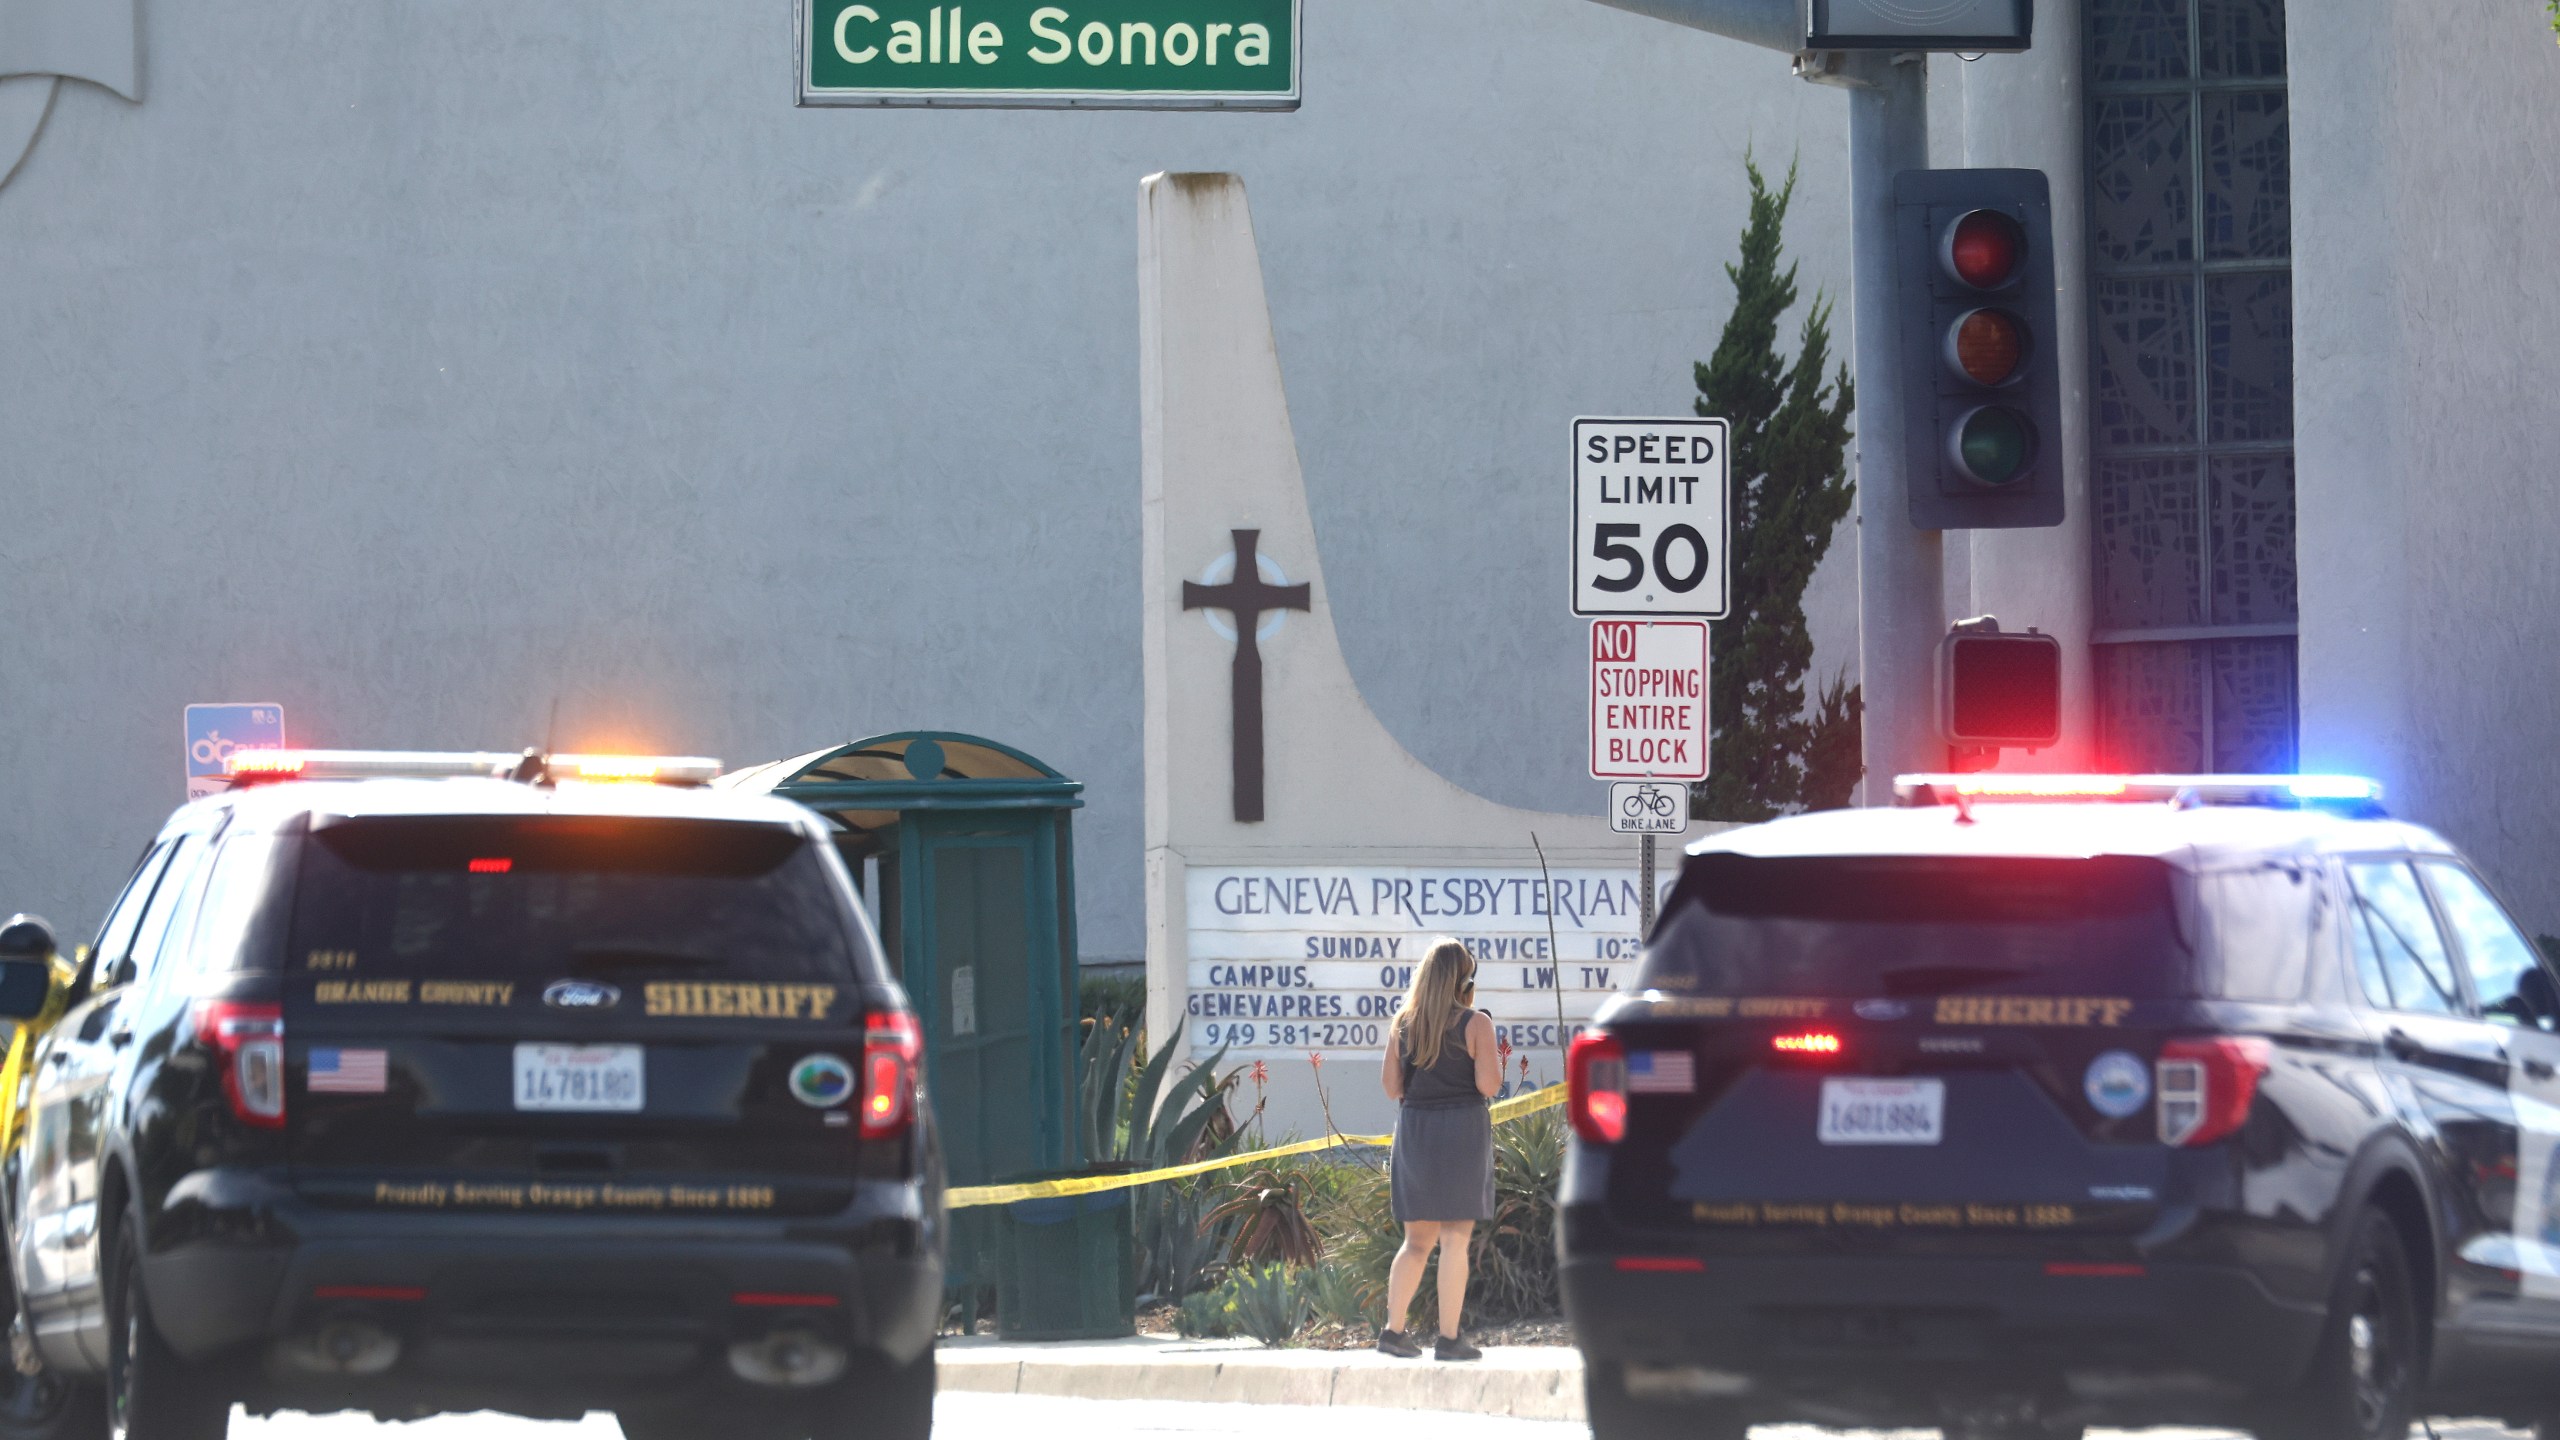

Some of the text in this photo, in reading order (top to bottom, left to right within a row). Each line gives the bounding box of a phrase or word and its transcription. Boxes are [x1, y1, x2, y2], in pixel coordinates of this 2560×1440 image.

[833, 4, 1271, 67] Calle Sonora
[1586, 435, 1715, 465] SPEED
[1600, 475, 1699, 505] LIMIT
[1591, 523, 1710, 594] 50
[1597, 624, 1634, 660] NO
[1600, 668, 1700, 698] STOPPING
[1606, 705, 1692, 731] ENTIRE
[1609, 738, 1688, 764] BLOCK
[1621, 818, 1676, 830] BIKE LANE
[1215, 876, 1360, 916] GENEVA
[1371, 878, 1641, 928] PRESBYTERIAN
[1305, 936, 1641, 960] SUNDAY ERVICE 10:3
[1209, 965, 1618, 990] CAMPUS. ON LW TV.
[420, 980, 514, 1006] COUNTY
[644, 982, 837, 1020] SHERIFF
[1935, 995, 2133, 1027] SHERIFF
[1206, 1023, 1256, 1046] 949
[1268, 1023, 1379, 1046] 581-2200
[530, 1183, 596, 1209] Orange
